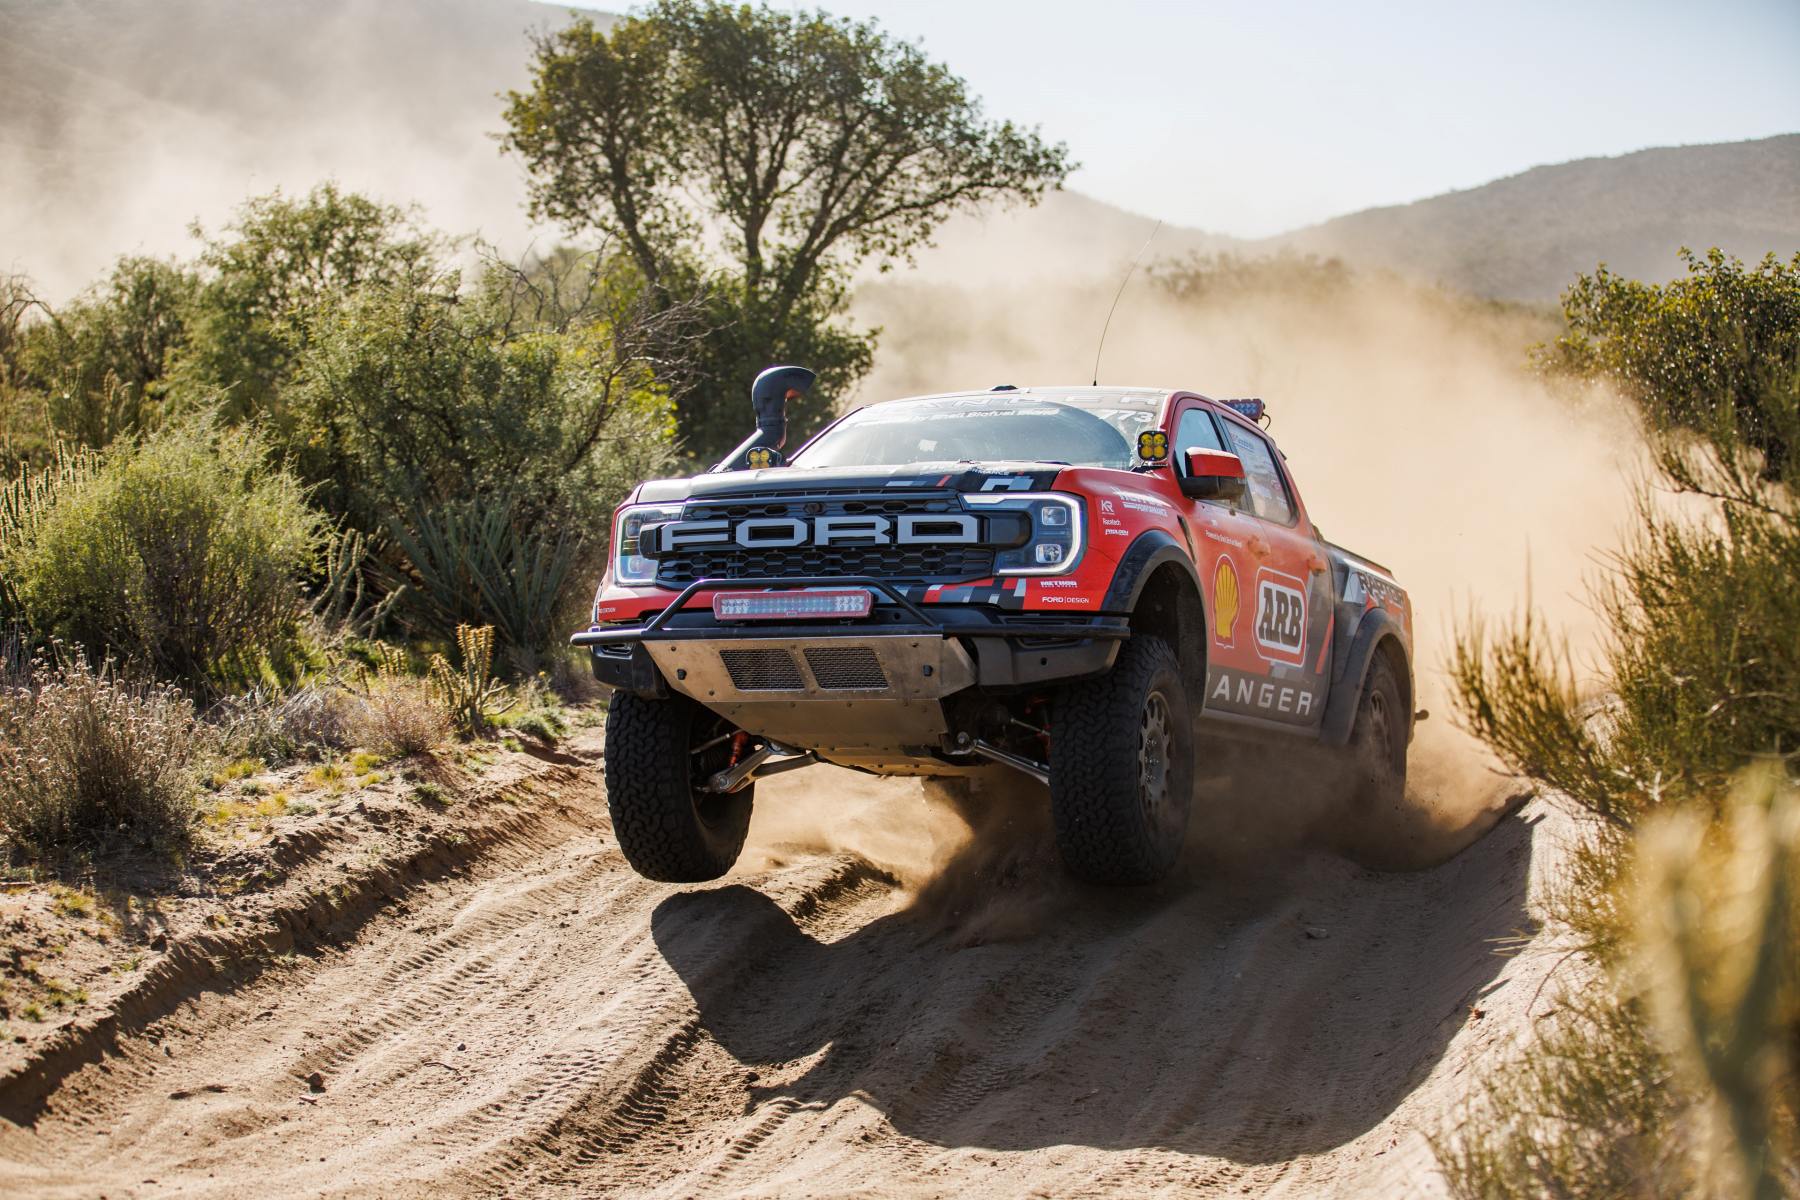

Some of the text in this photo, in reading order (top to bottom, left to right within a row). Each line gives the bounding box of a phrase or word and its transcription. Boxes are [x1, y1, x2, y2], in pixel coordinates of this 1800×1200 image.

[966, 409, 1014, 417] Biofuel
[1099, 409, 1154, 422] 773
[661, 514, 978, 551] FORD
[1259, 586, 1303, 648] ARB
[1207, 672, 1312, 716] ANGER
